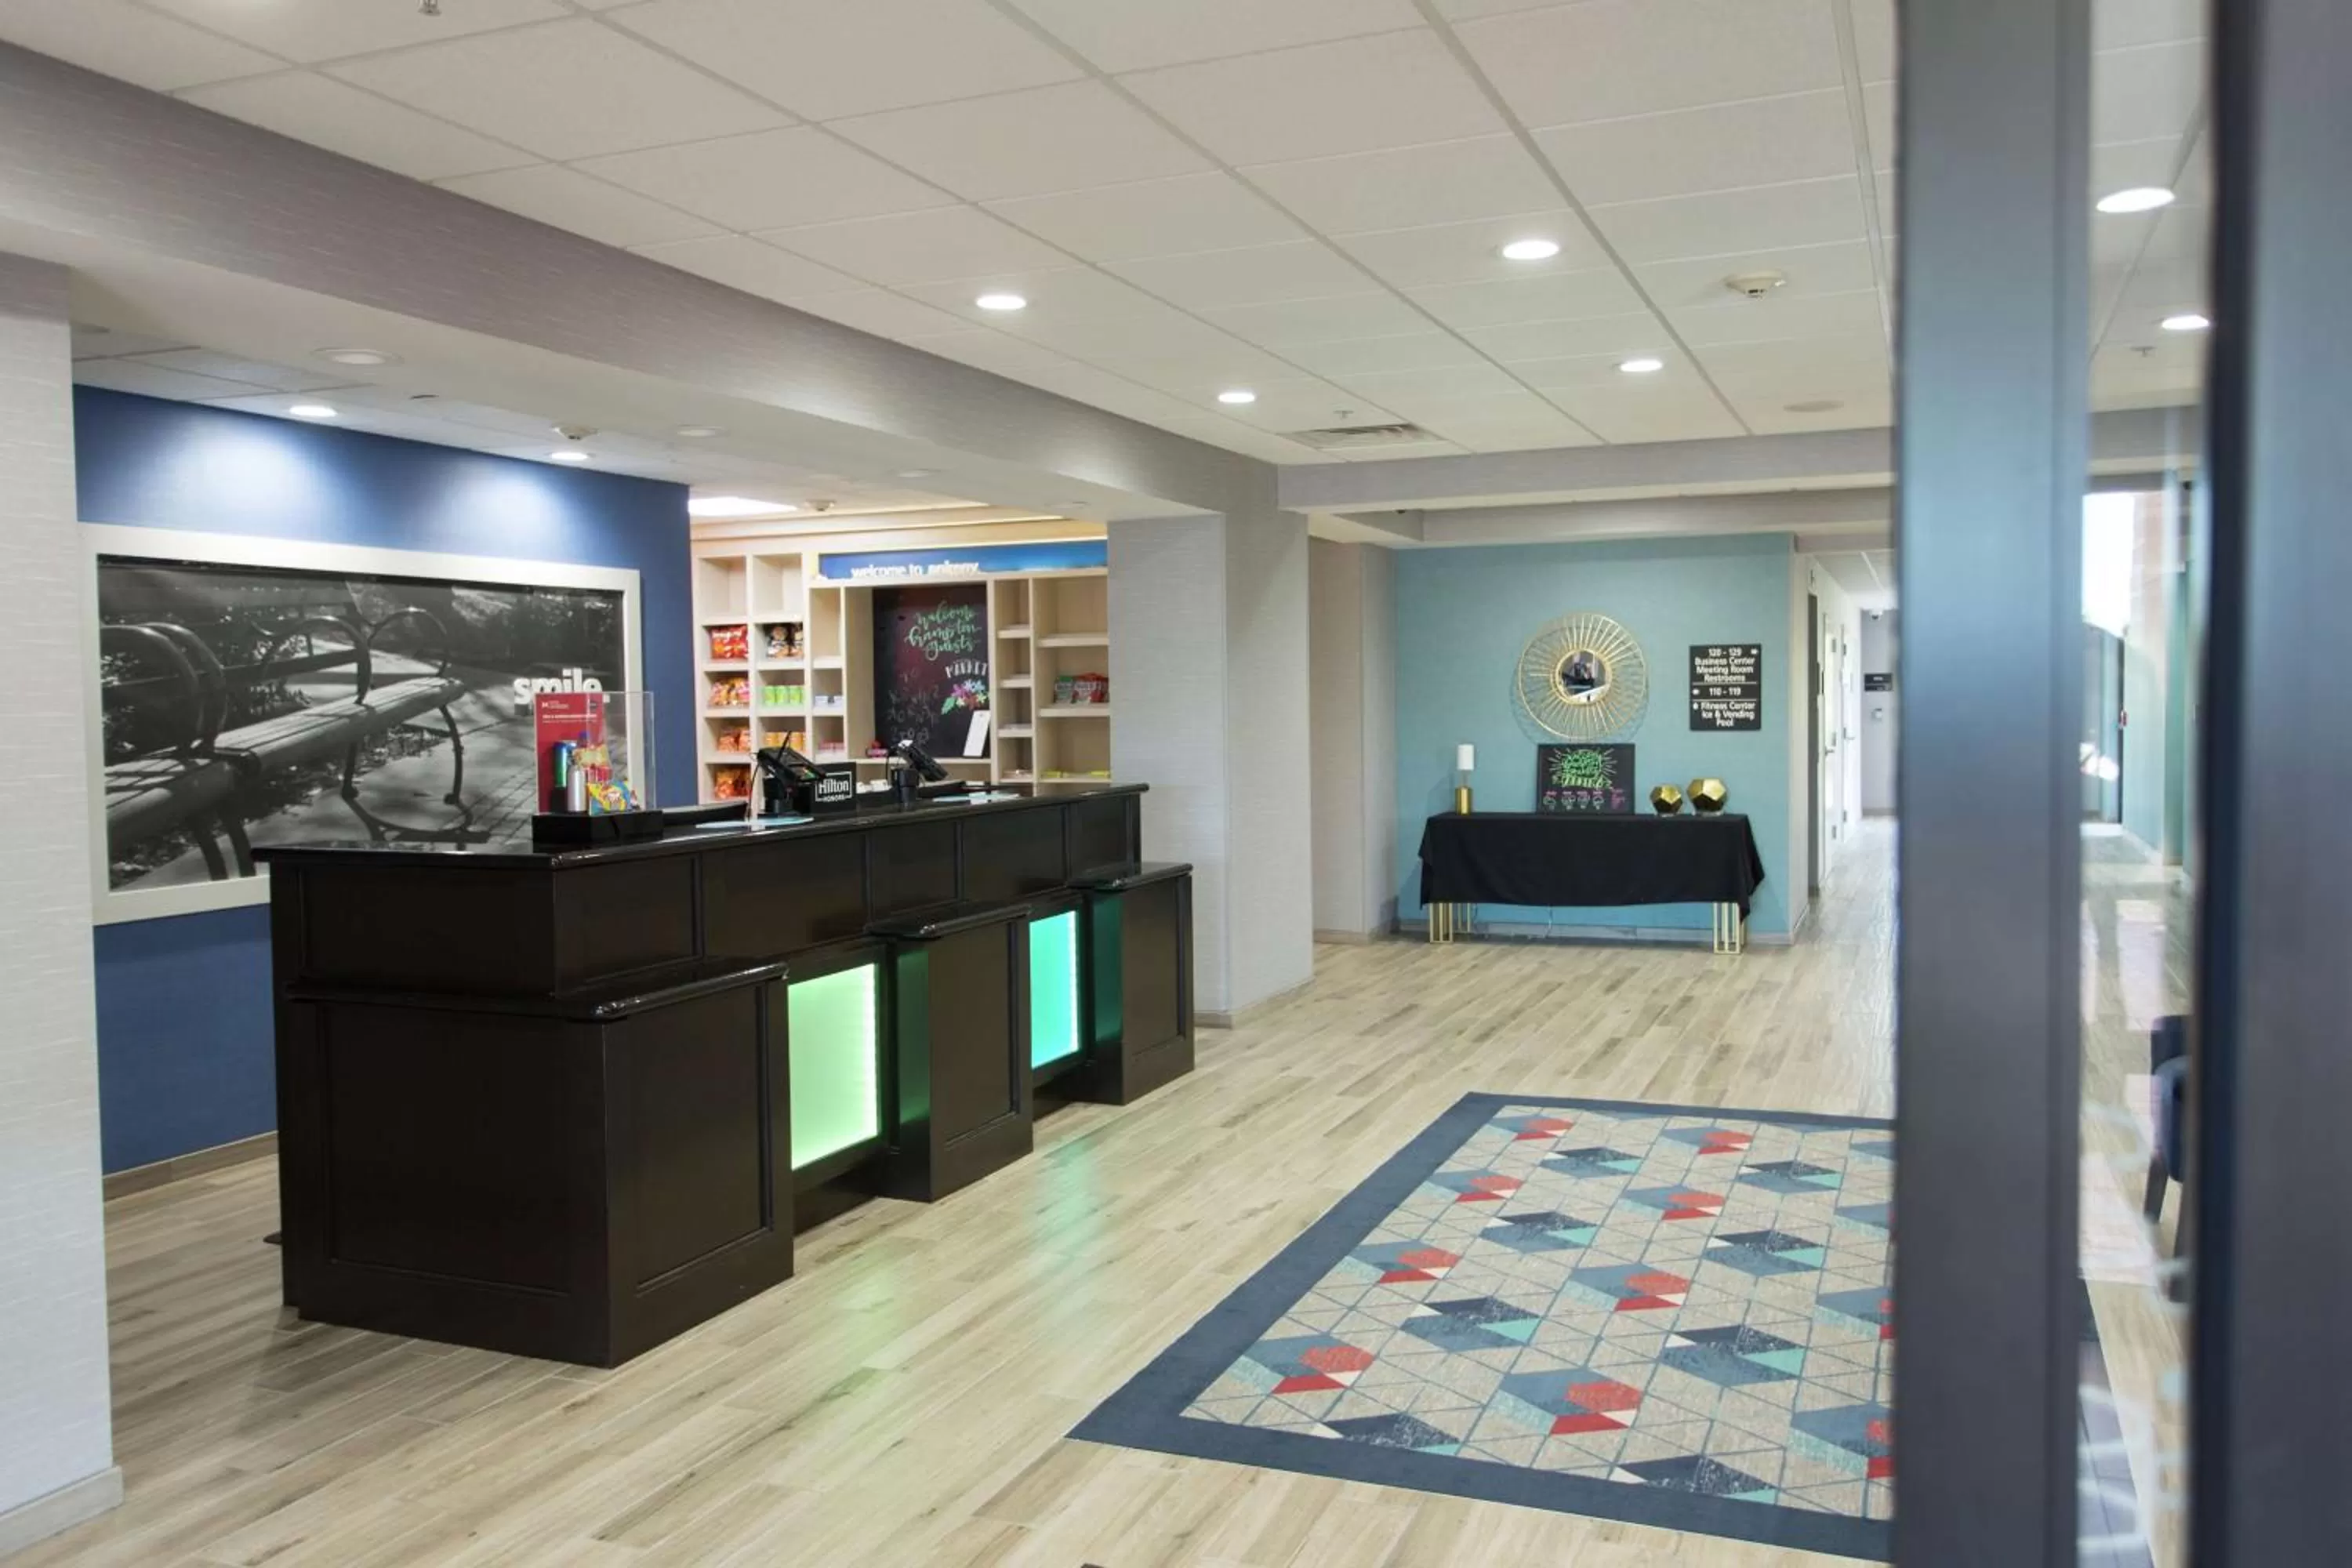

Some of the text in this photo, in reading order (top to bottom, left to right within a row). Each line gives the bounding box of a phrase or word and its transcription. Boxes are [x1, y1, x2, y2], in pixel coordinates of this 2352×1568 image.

[851, 564, 906, 578] welcome
[909, 562, 924, 577] to
[1694, 656, 1755, 666] Business Center
[1696, 666, 1729, 675] Meeting
[1700, 702, 1755, 710] Fitness Center
[1701, 710, 1713, 719] Ice
[1722, 710, 1755, 720] Vending
[1716, 718, 1734, 728] Pool
[818, 778, 849, 794] Hilton
